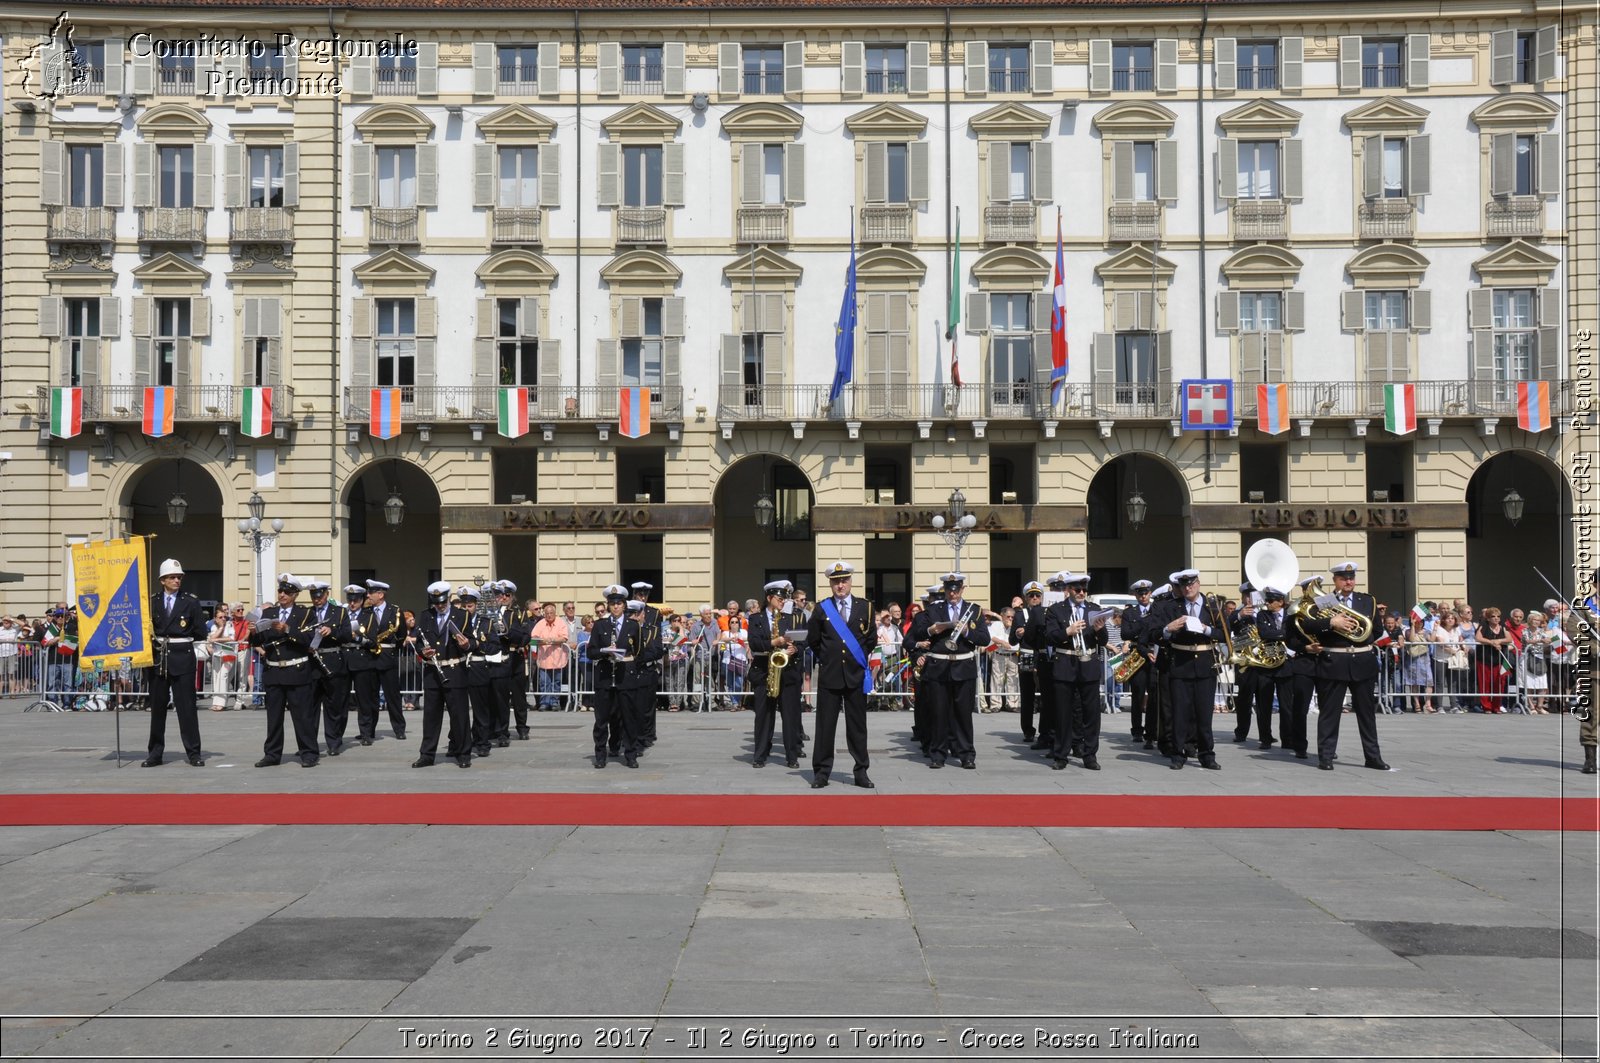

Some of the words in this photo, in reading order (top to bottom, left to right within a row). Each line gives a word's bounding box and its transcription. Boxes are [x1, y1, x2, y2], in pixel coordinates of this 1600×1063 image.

[502, 508, 651, 529] PALAZZO
[896, 510, 1003, 529] DELA
[1250, 507, 1410, 528] REGIONE
[107, 558, 132, 566] TORINO
[107, 609, 139, 617] MUSICALE
